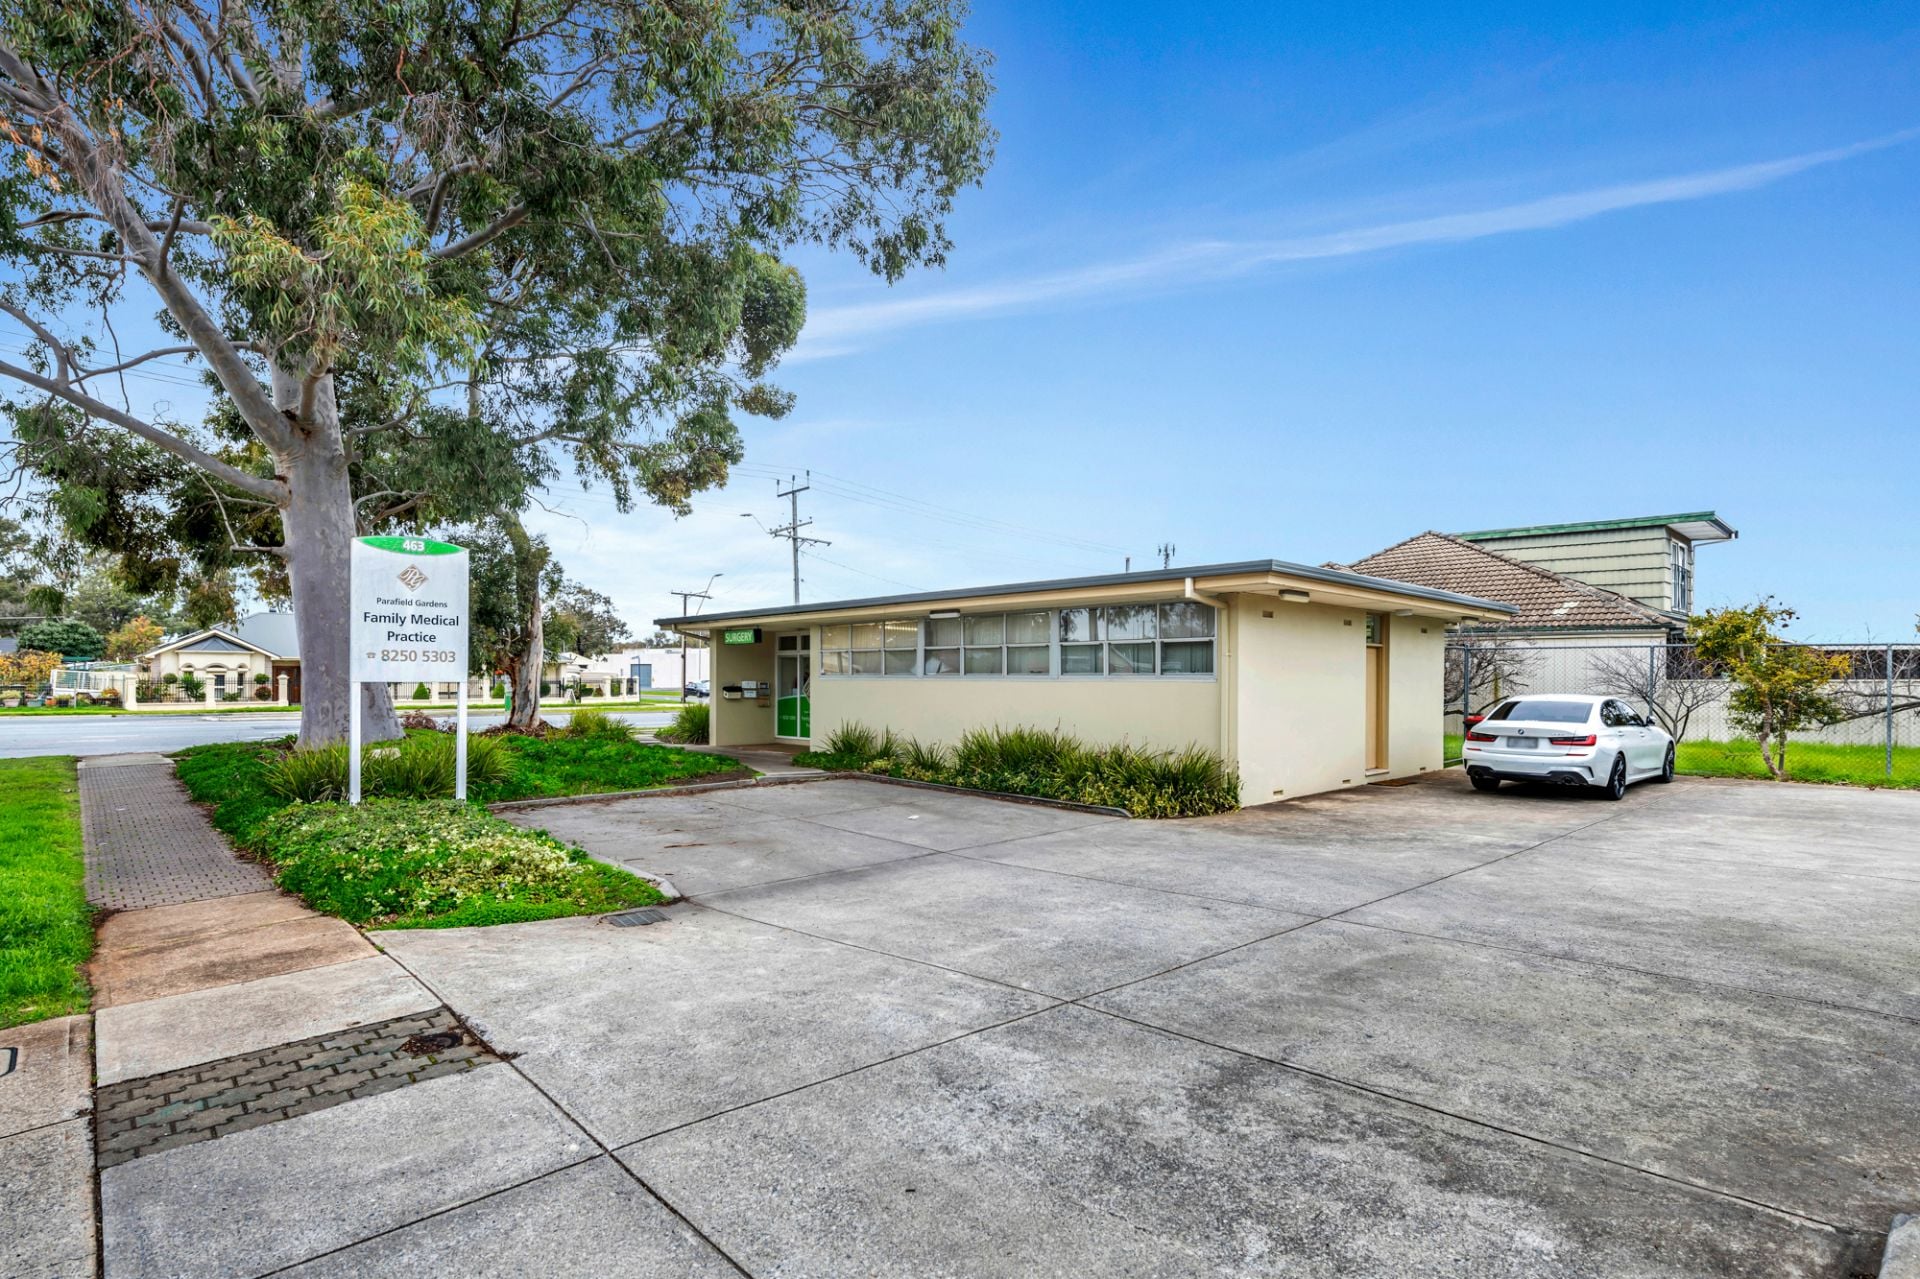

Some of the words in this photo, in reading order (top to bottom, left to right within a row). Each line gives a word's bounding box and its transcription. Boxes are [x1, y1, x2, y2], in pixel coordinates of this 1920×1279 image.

[403, 540, 425, 550] 463
[377, 597, 413, 606] Parafield
[415, 599, 448, 608] Gardens
[363, 612, 407, 627] Family
[410, 614, 459, 626] Medical
[387, 631, 436, 643] Practice
[725, 632, 753, 643] SURGERY
[381, 649, 418, 662] 8250
[421, 650, 456, 663] 5303
